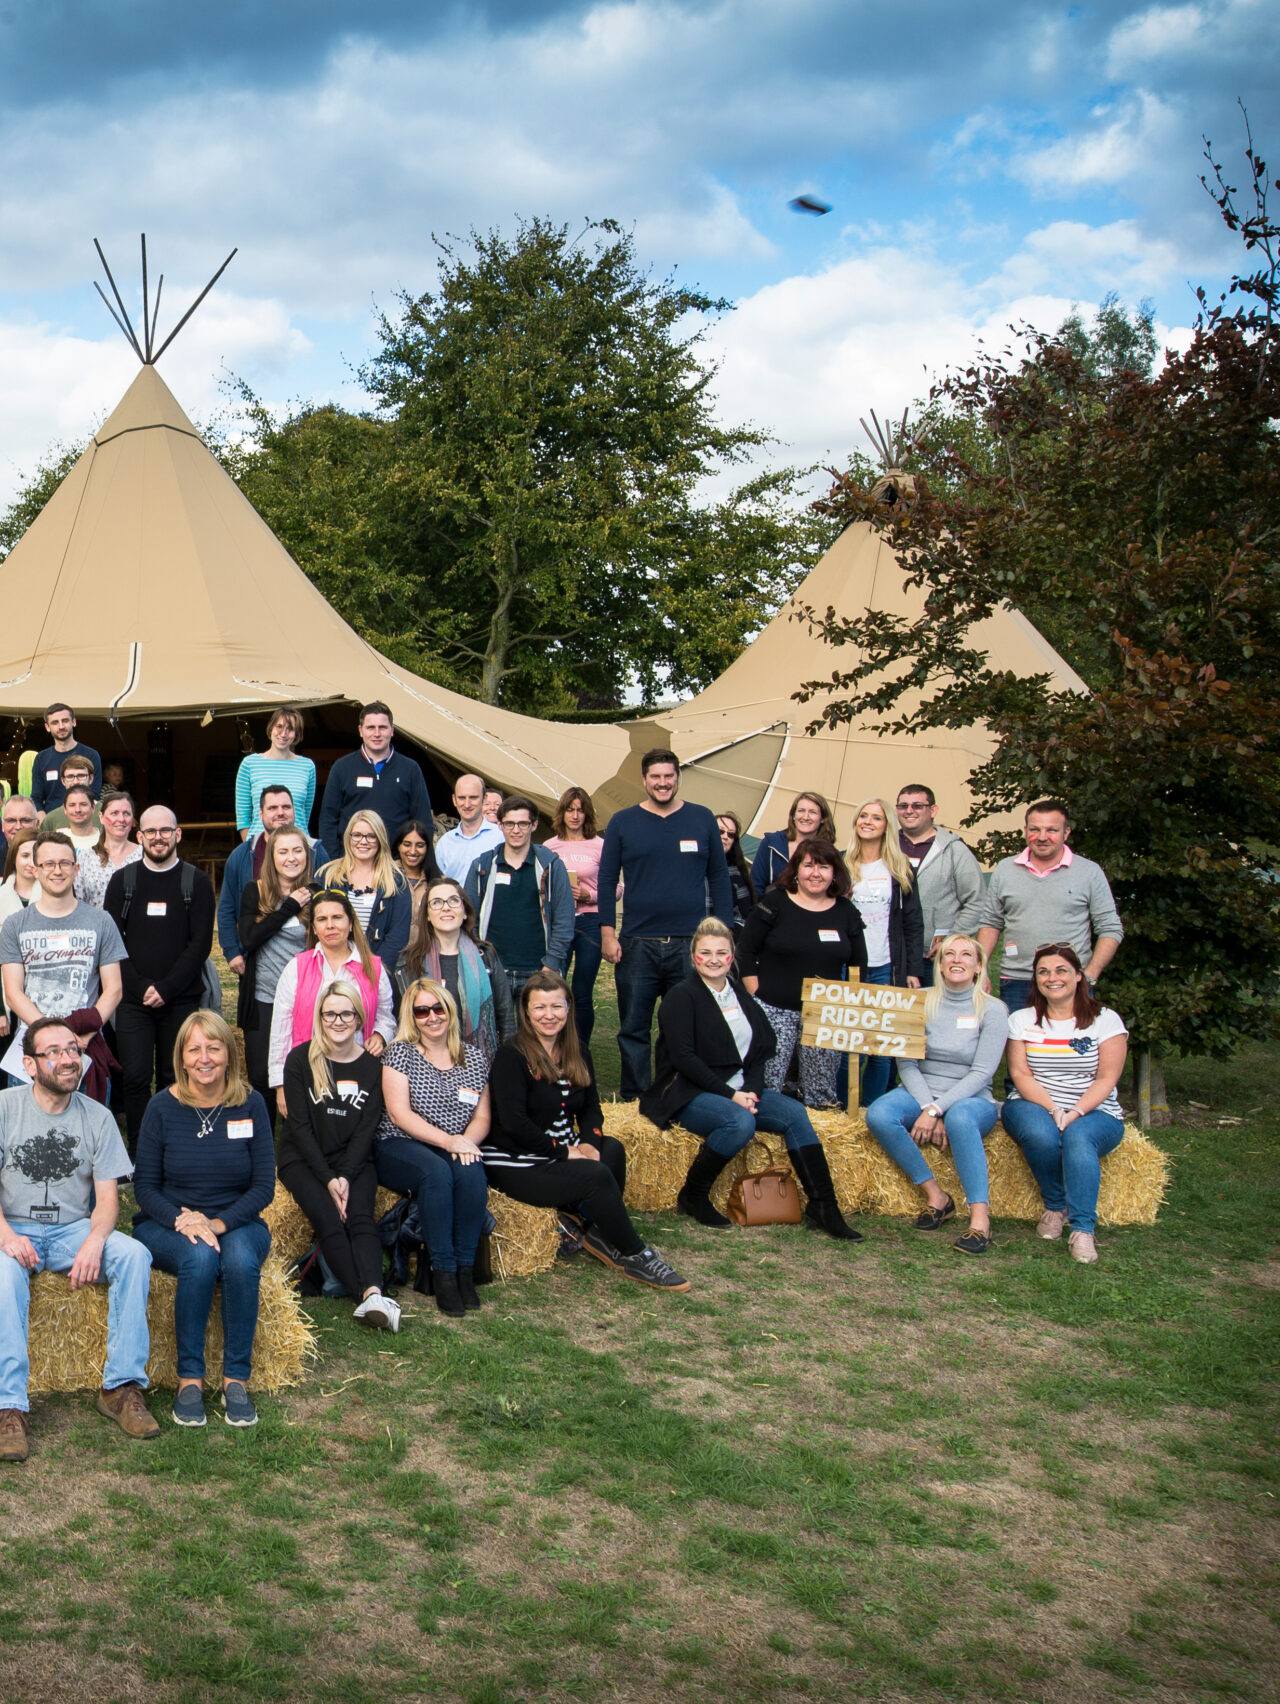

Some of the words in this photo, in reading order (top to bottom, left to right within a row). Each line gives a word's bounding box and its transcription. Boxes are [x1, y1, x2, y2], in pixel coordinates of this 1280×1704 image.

[810, 982, 917, 1010] POWWOW
[820, 1005, 896, 1032] RIDGE
[815, 1027, 870, 1051] POP.
[876, 1034, 907, 1056] 72
[309, 1087, 334, 1104] LA
